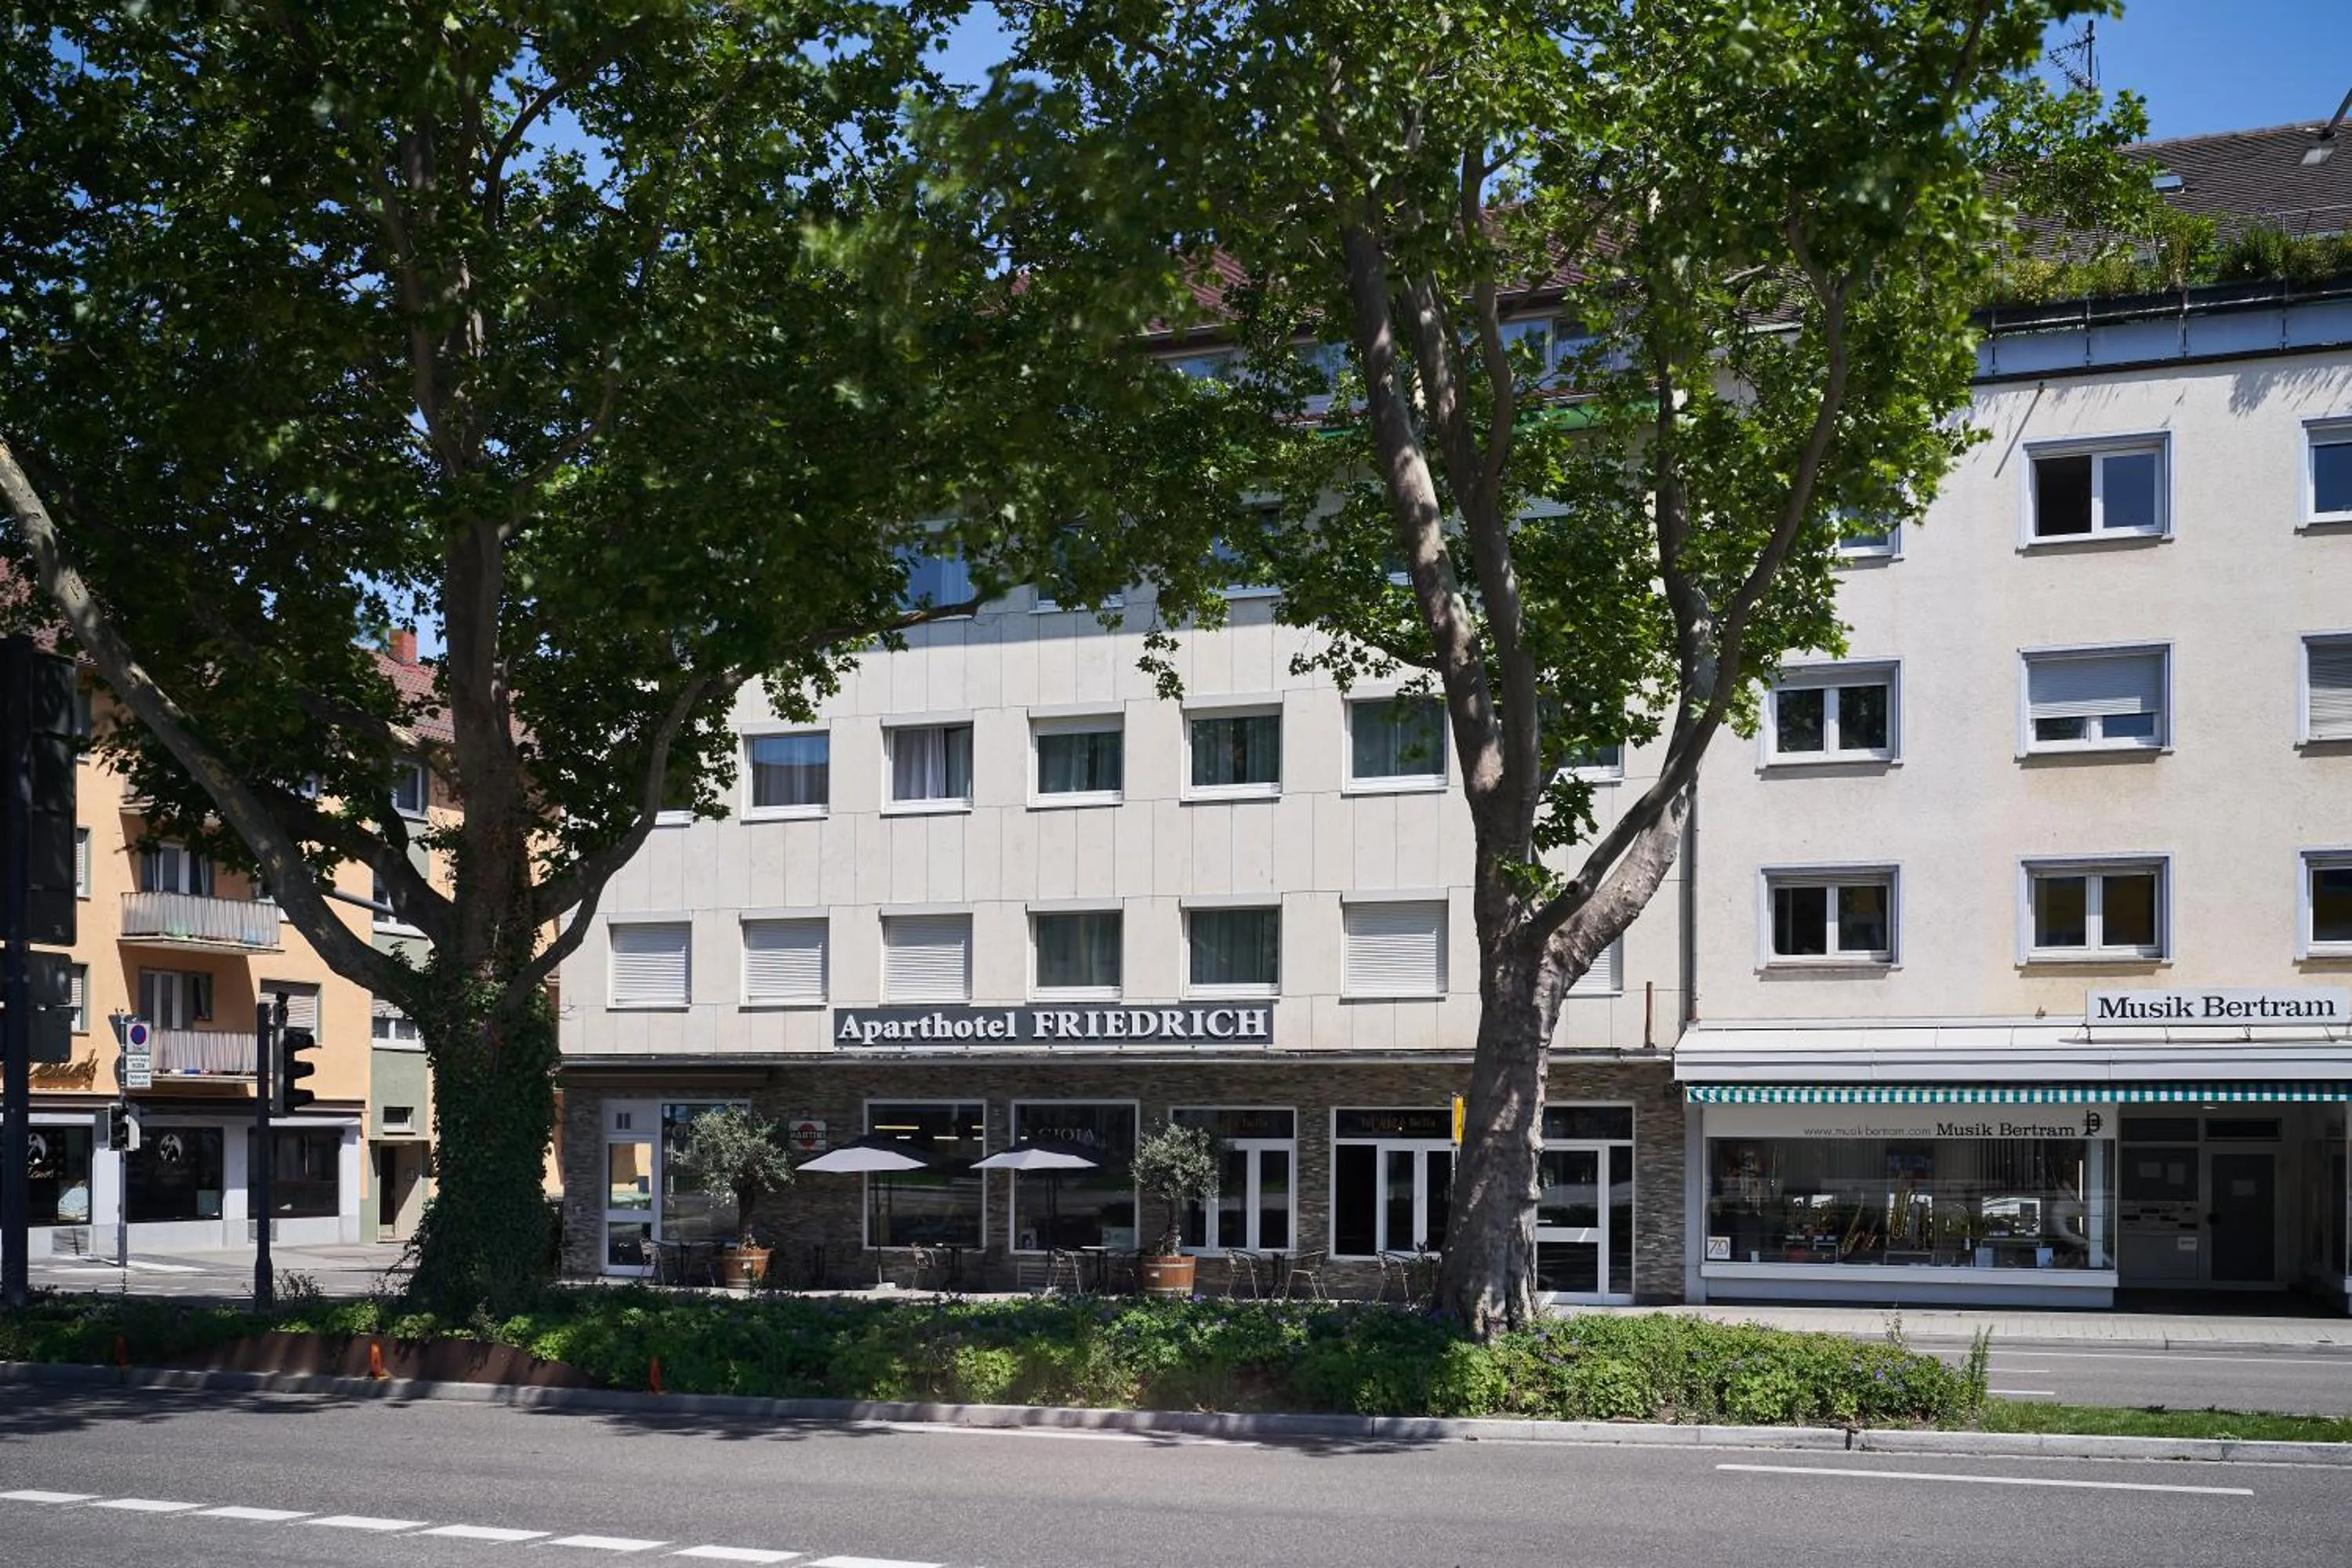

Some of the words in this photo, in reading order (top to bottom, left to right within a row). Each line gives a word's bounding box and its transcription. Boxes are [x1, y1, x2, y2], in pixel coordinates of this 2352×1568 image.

[2097, 996, 2194, 1018] Musik
[2201, 995, 2336, 1017] Bertram
[837, 1012, 1017, 1044] Aparthotel
[1032, 1009, 1267, 1037] FRIEDRICH
[1936, 1123, 1993, 1136] Musik
[2000, 1123, 2075, 1136] Bertram
